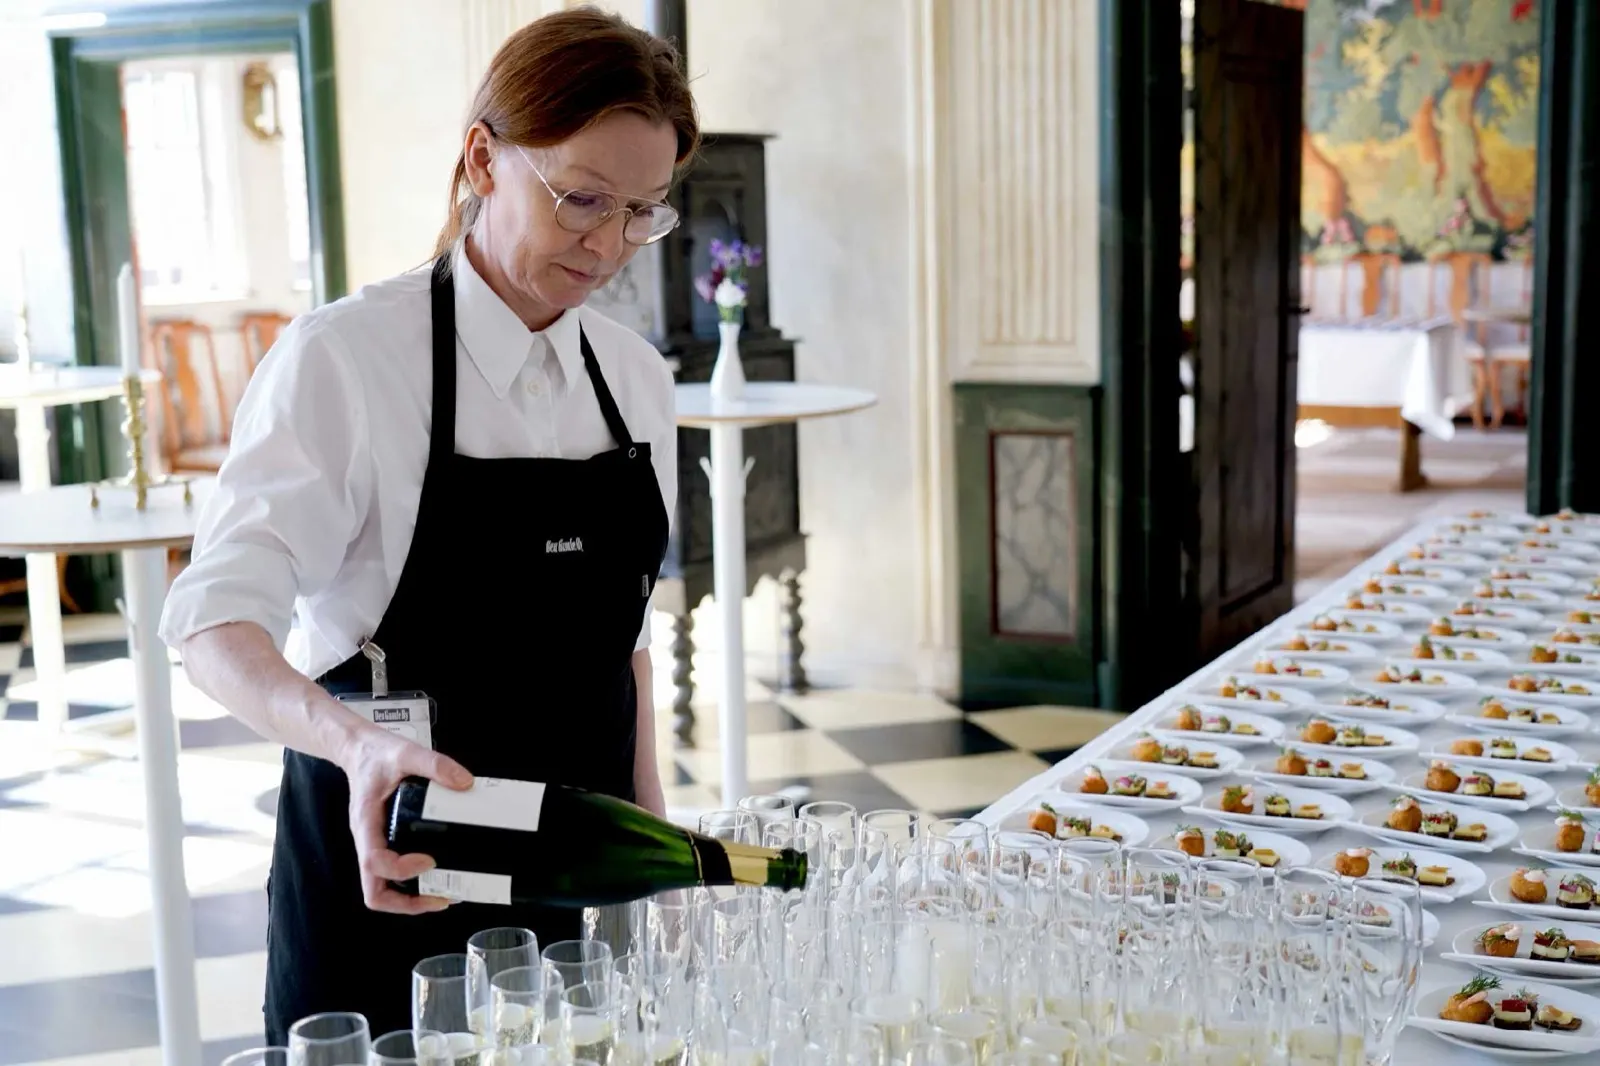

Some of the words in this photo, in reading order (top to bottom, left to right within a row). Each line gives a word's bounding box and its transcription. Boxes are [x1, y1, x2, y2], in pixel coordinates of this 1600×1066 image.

[375, 710, 384, 721] Den
[385, 710, 401, 720] Gamle
[402, 709, 409, 721] By
